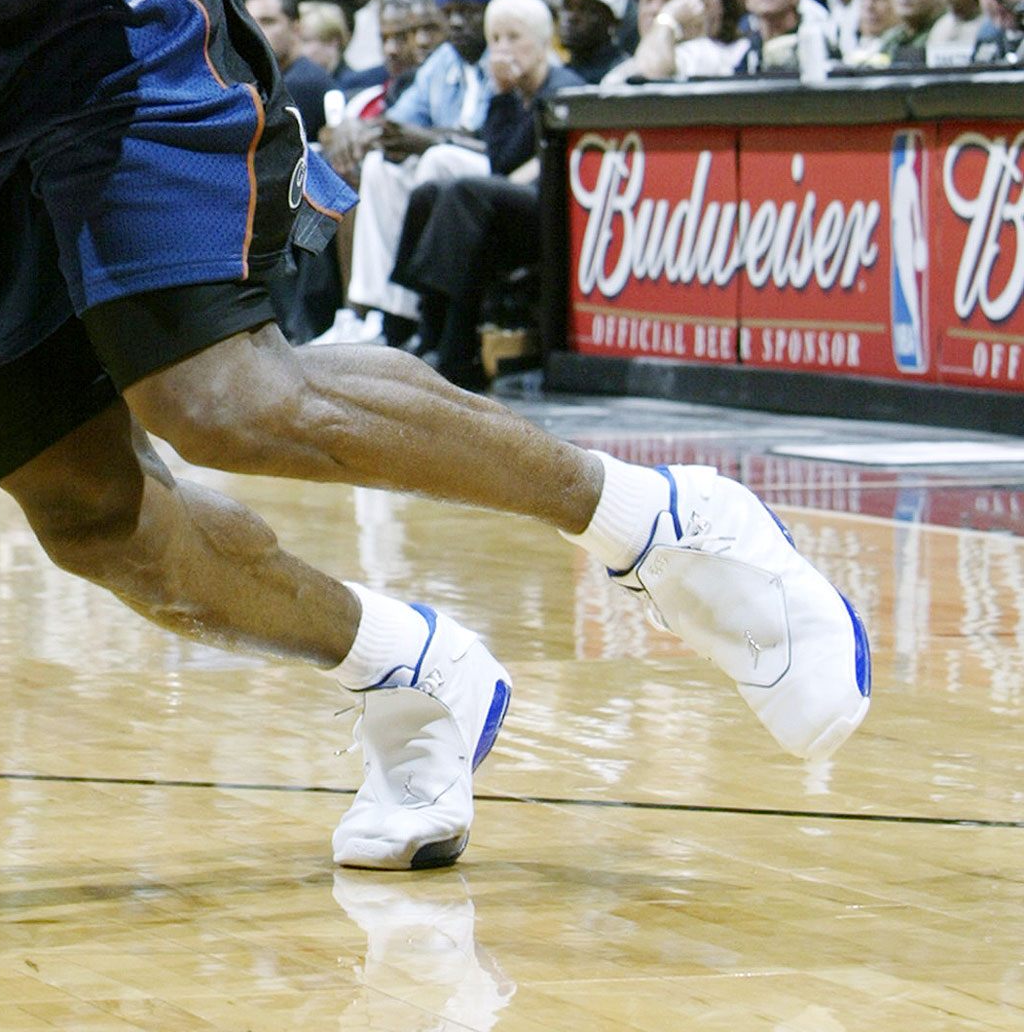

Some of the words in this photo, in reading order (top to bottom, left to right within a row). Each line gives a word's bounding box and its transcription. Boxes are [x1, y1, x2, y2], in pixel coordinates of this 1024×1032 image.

[570, 132, 881, 298] Budweiser
[592, 314, 686, 355] OFFICIAL
[694, 323, 751, 360] BEER
[762, 328, 860, 367] SPONSOR
[972, 341, 1021, 380] OFF
